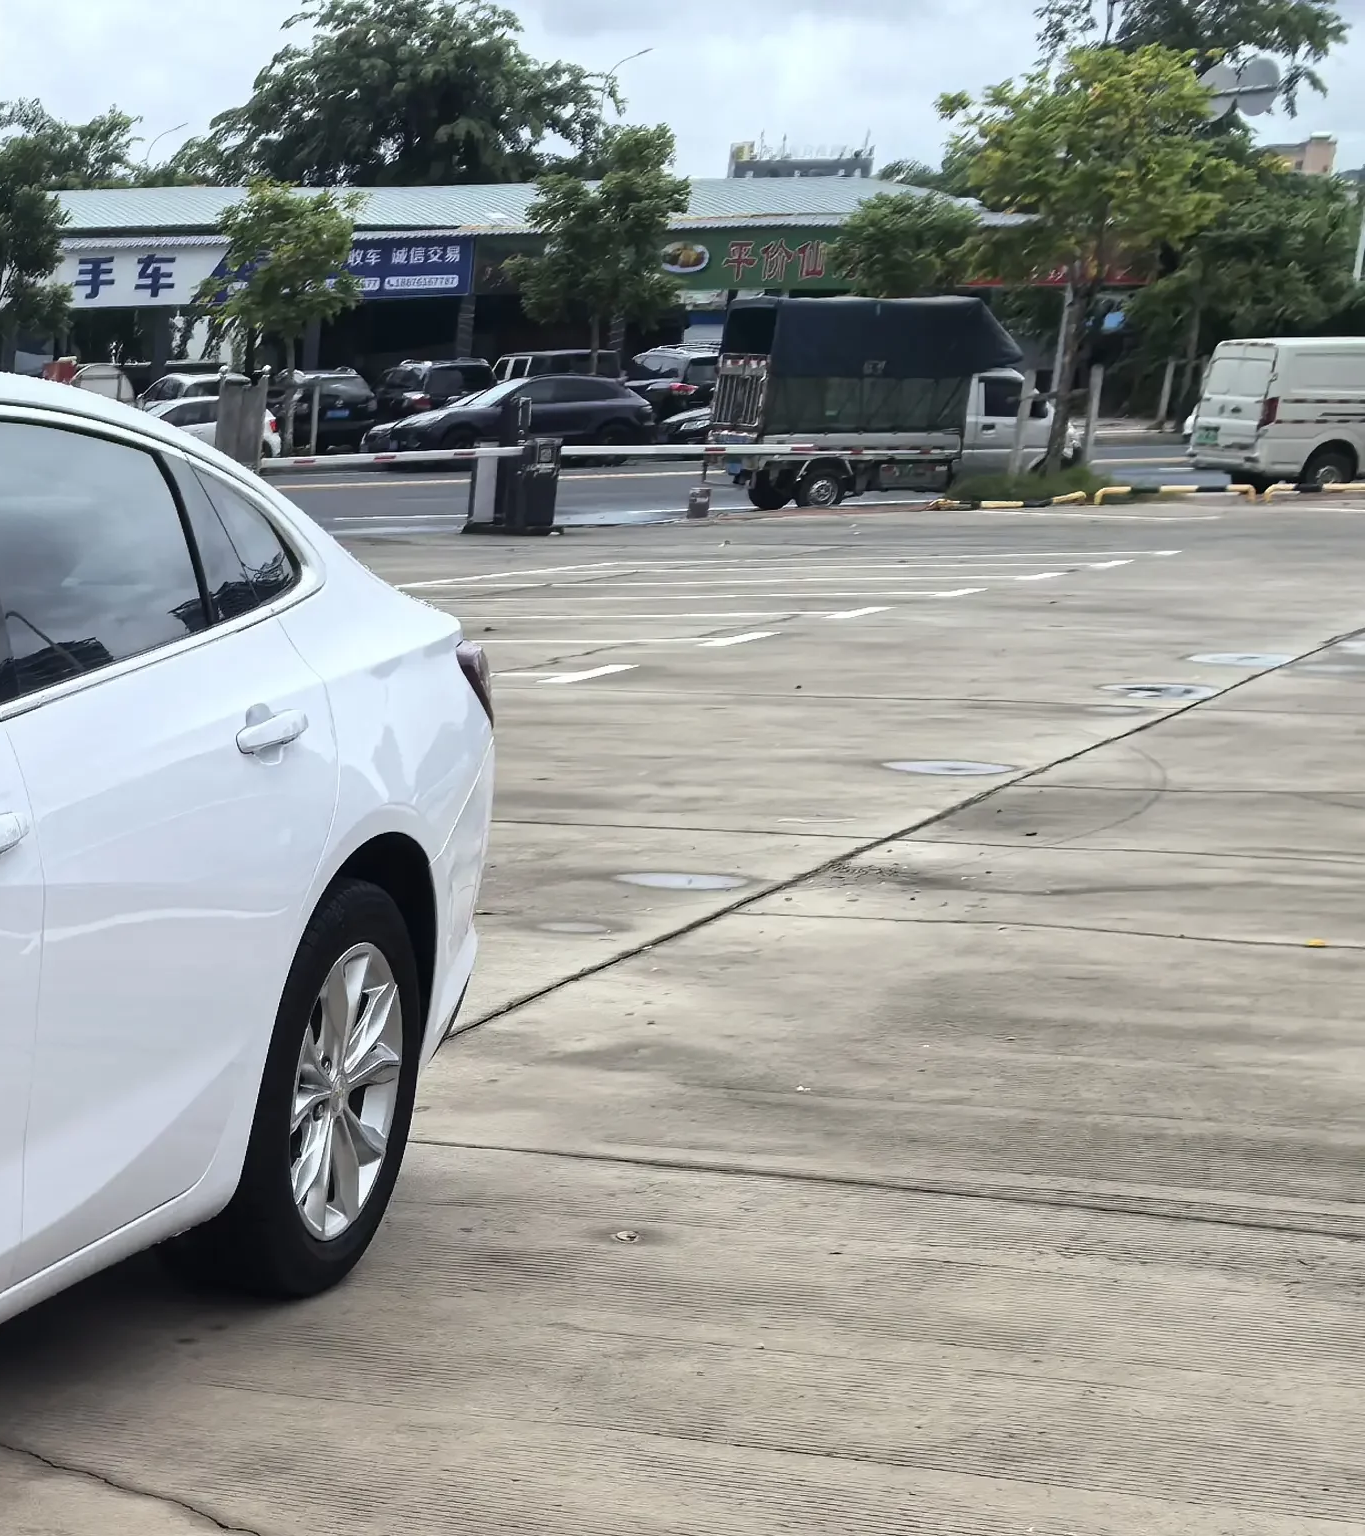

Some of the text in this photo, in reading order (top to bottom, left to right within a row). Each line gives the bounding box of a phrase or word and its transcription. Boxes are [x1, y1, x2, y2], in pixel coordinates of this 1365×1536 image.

[391, 245, 461, 265] 诚信交易
[722, 240, 858, 282] 平价仙
[74, 254, 177, 299] 手车
